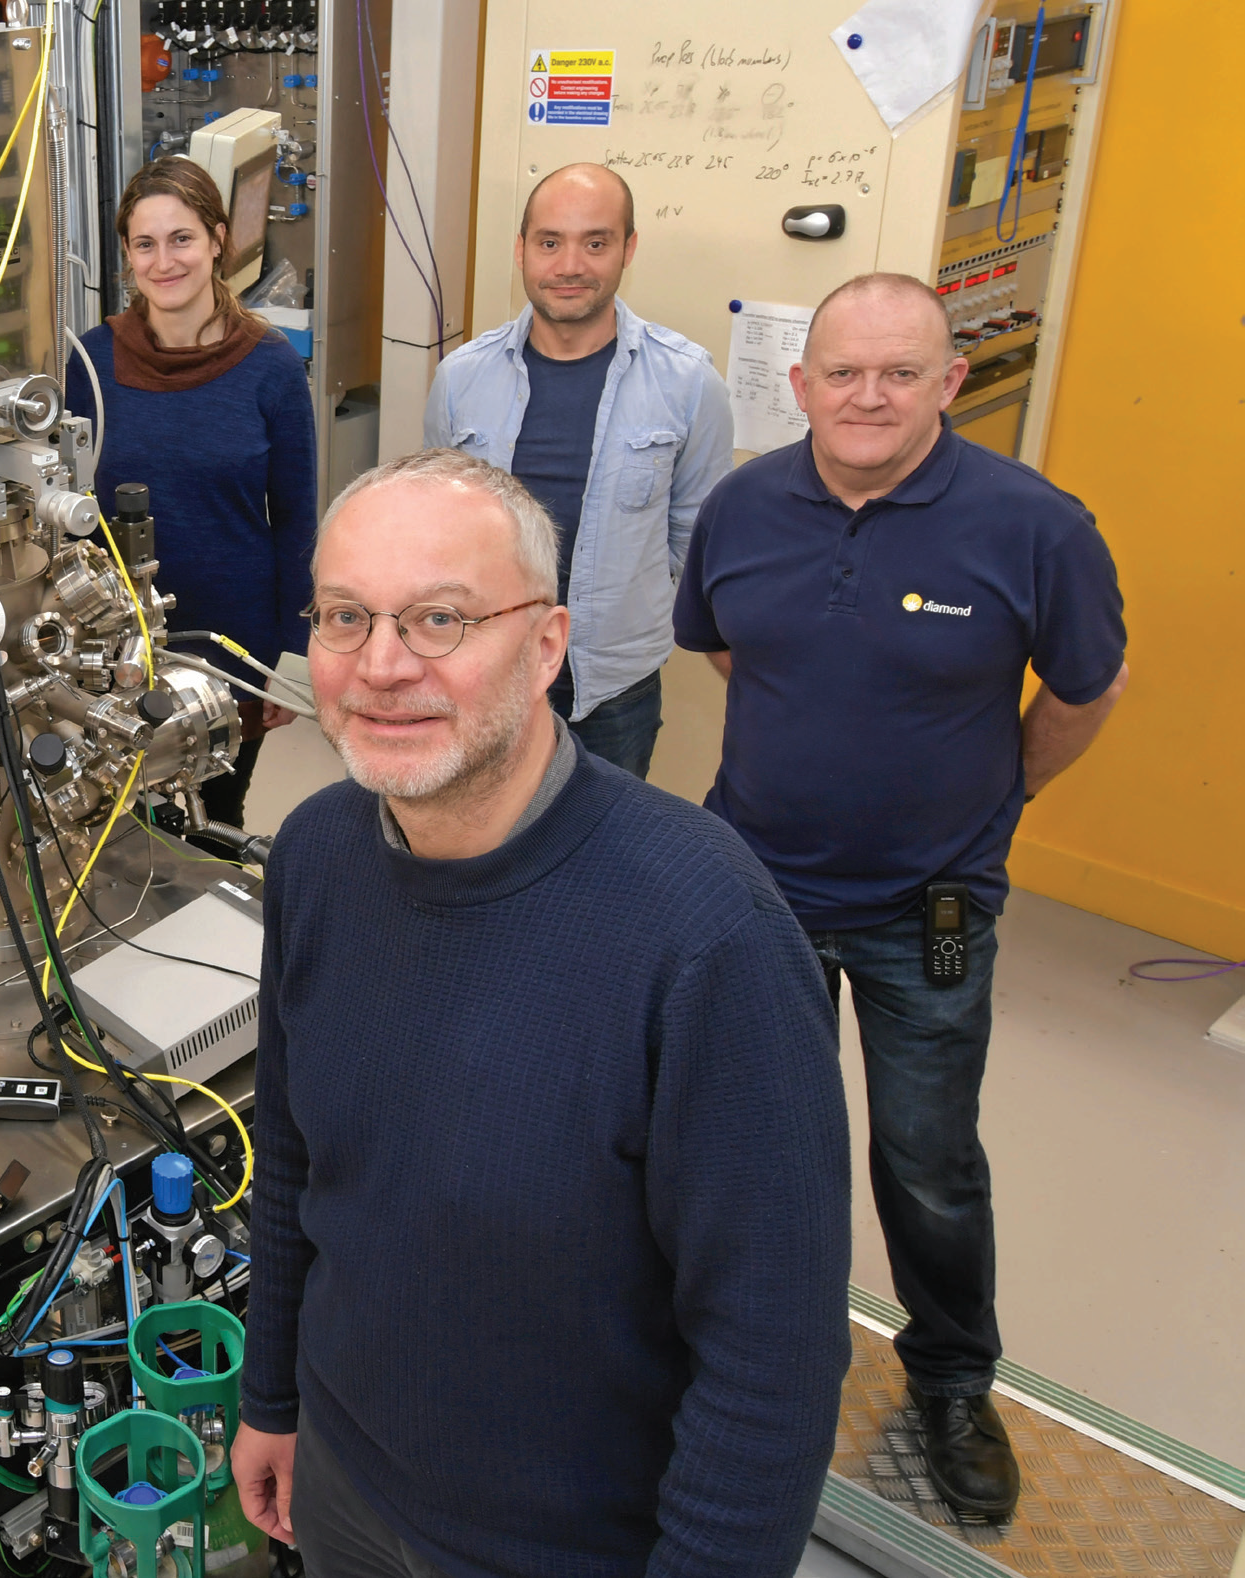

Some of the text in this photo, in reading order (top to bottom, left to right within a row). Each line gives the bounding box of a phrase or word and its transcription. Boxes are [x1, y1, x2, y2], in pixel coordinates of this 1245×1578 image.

[551, 58, 576, 67] Danger
[578, 58, 596, 66] 230V
[923, 600, 972, 617] diamond
